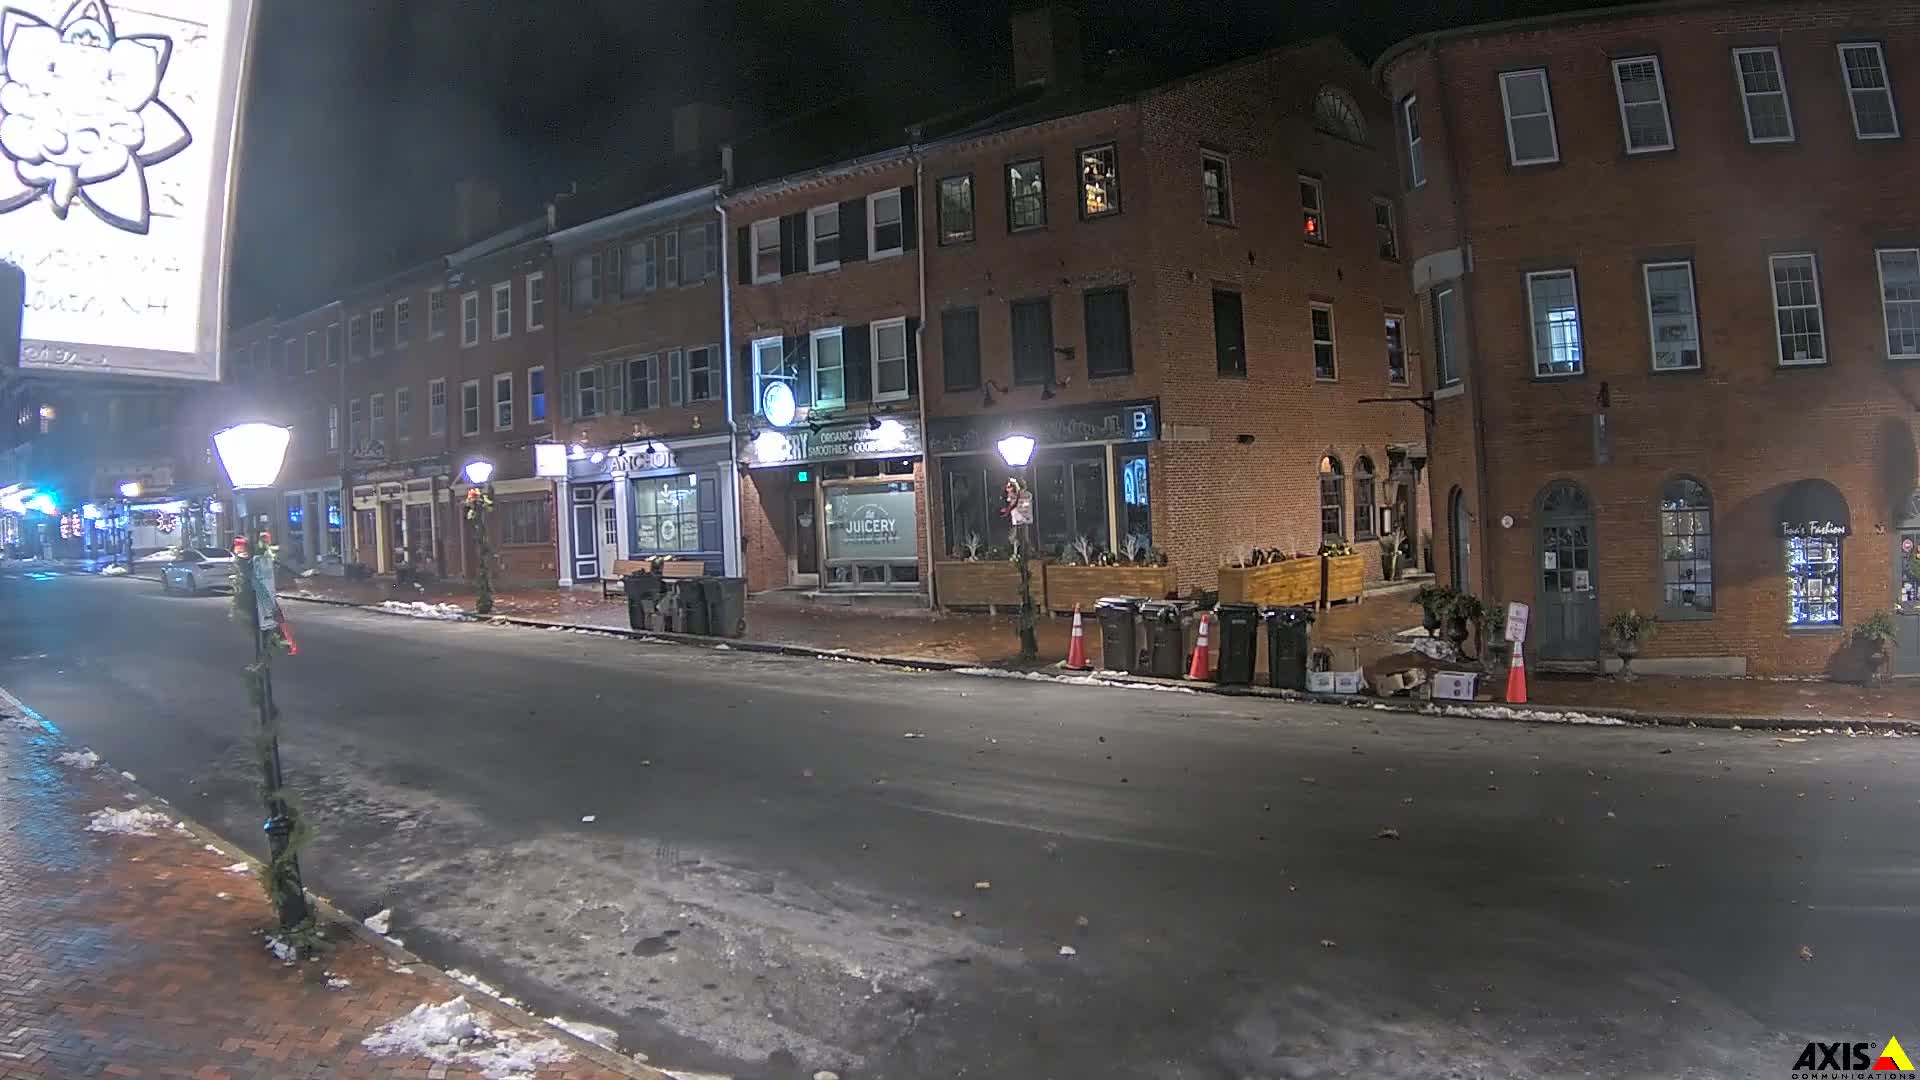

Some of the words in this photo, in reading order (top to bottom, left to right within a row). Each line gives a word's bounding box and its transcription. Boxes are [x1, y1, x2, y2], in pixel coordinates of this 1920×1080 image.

[1133, 411, 1147, 431] B
[821, 430, 853, 444] ORGANIC
[808, 444, 848, 457] SMOOTHIES
[846, 518, 896, 534] JUICERY
[1808, 519, 1845, 536] Fashion
